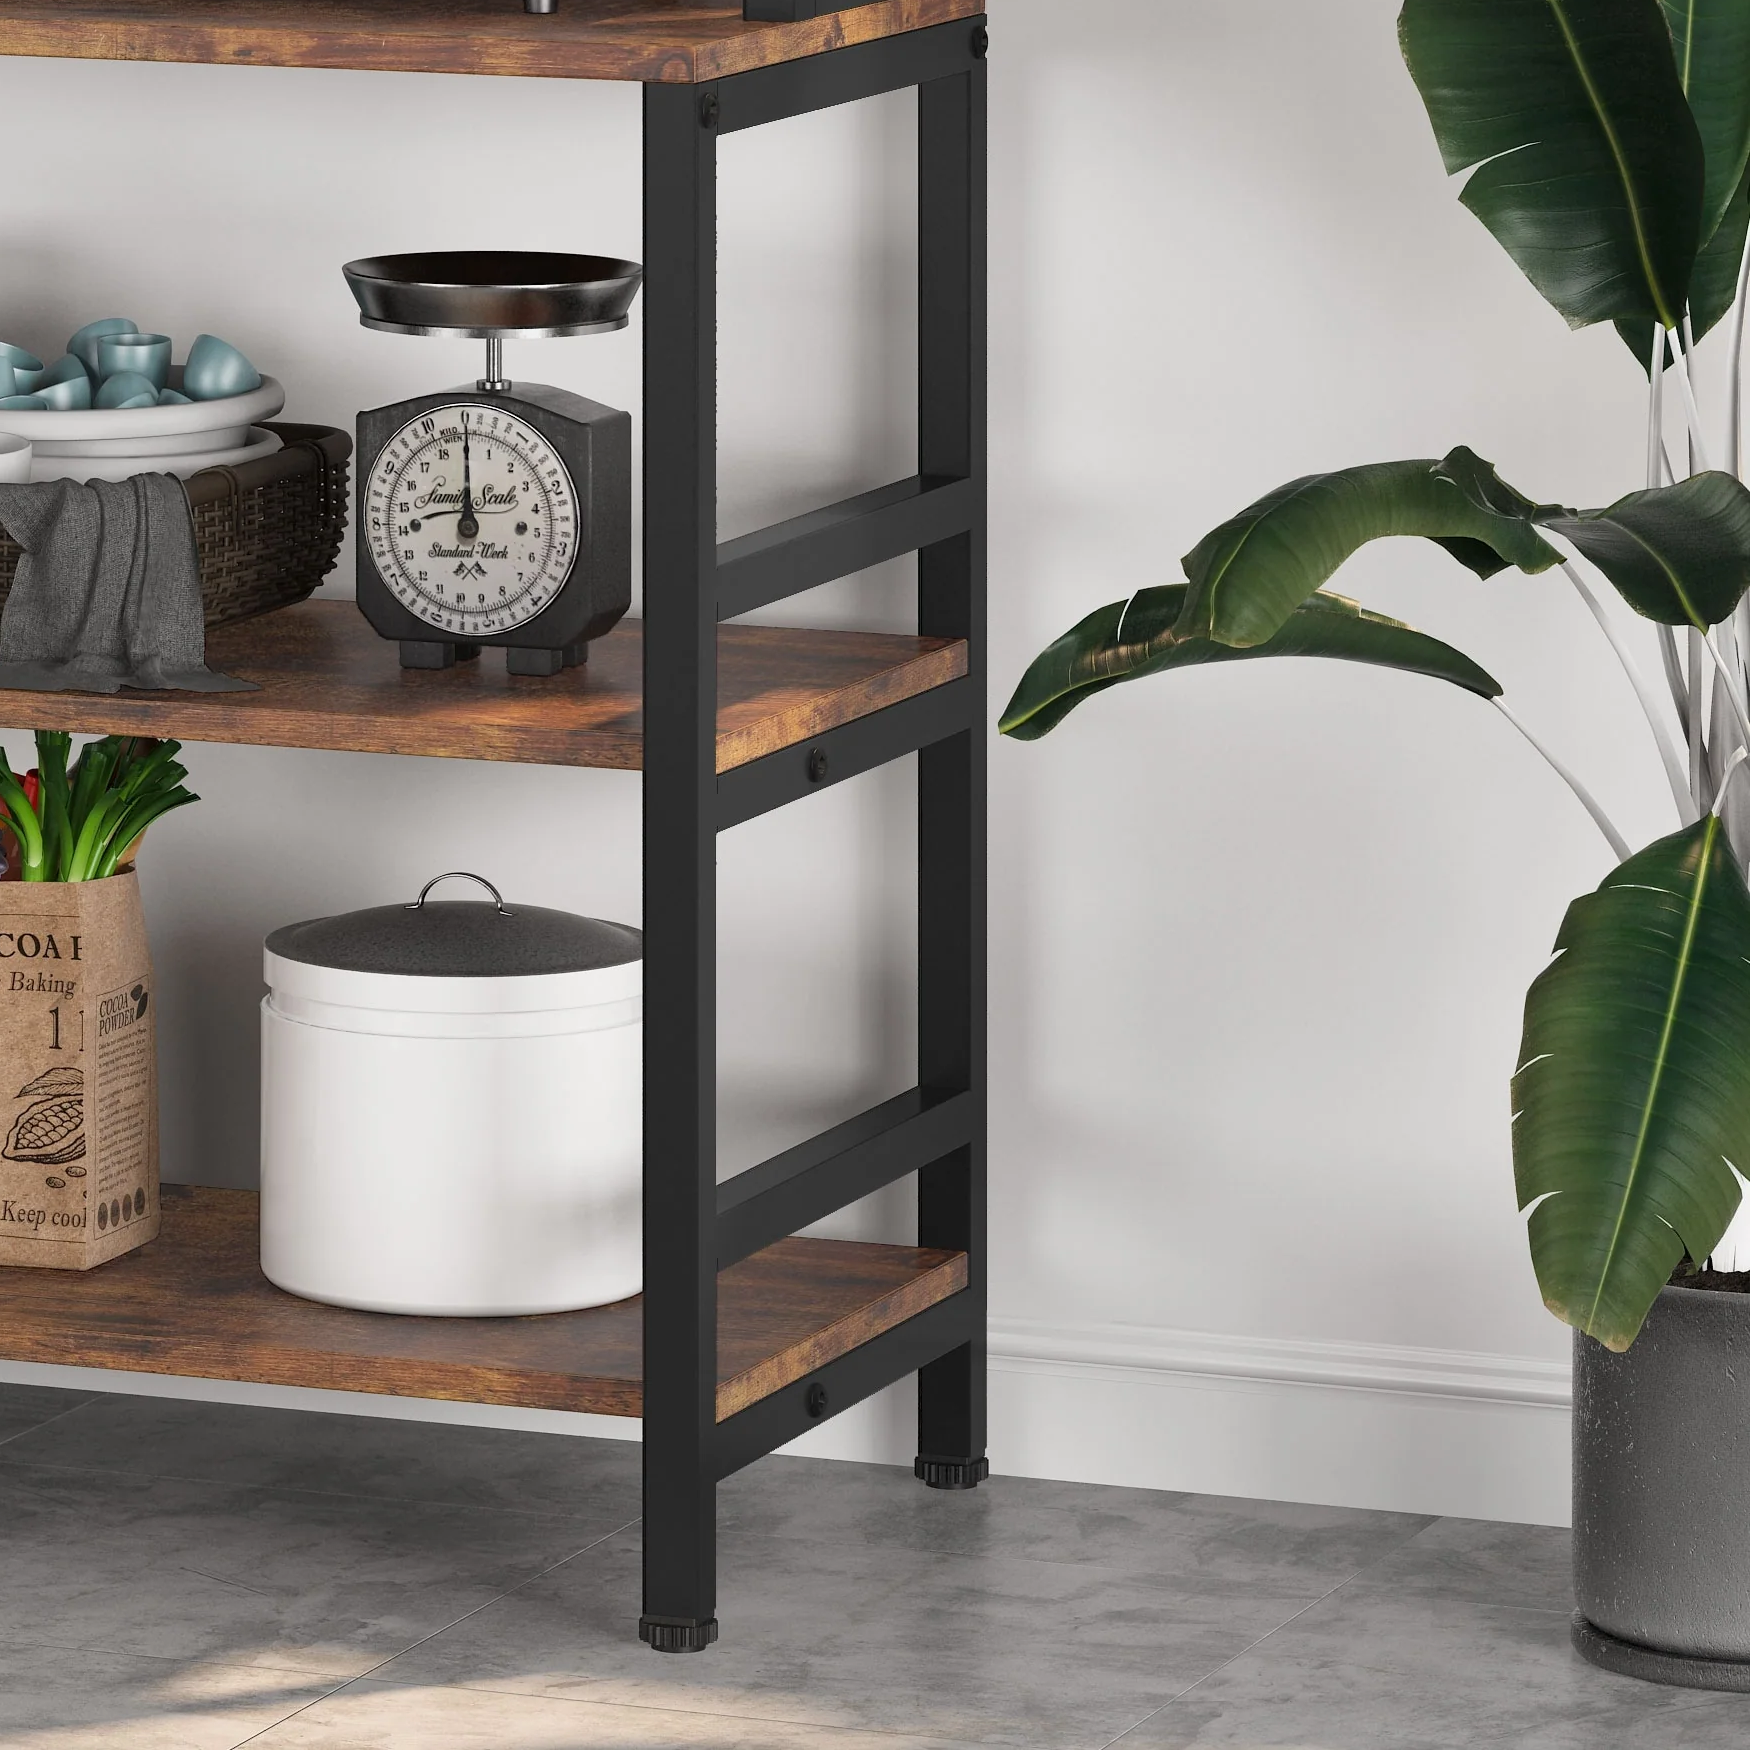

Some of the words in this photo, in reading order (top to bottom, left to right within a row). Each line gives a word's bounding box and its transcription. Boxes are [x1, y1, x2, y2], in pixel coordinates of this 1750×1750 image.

[461, 410, 469, 425] 0
[421, 417, 434, 434] 10
[438, 448, 449, 460] 18
[487, 449, 491, 460] 1
[384, 461, 394, 475] 9
[420, 462, 430, 473] 17
[507, 462, 514, 473] 2
[407, 480, 417, 491] 16
[522, 481, 529, 492] 3
[551, 480, 563, 496] 2
[471, 484, 518, 511] Scale
[399, 502, 410, 513] 15
[531, 503, 540, 514] 4
[372, 517, 381, 531] 8
[399, 525, 409, 536] 14
[533, 527, 541, 539] 5
[557, 541, 567, 557] 3
[404, 550, 414, 561] 13
[529, 552, 536, 563] 6
[390, 573, 399, 586] 7
[418, 570, 428, 581] 12
[517, 572, 523, 582] 7
[436, 584, 443, 595] 11
[498, 586, 506, 596] 8
[456, 593, 465, 604] 10
[478, 593, 485, 604] 9
[530, 595, 542, 607] 4
[8, 971, 77, 1000] Baking
[99, 992, 129, 1018] COCOA
[99, 1007, 135, 1037] POWDER
[48, 1006, 62, 1050] 1
[0, 1200, 46, 1231] Keep
